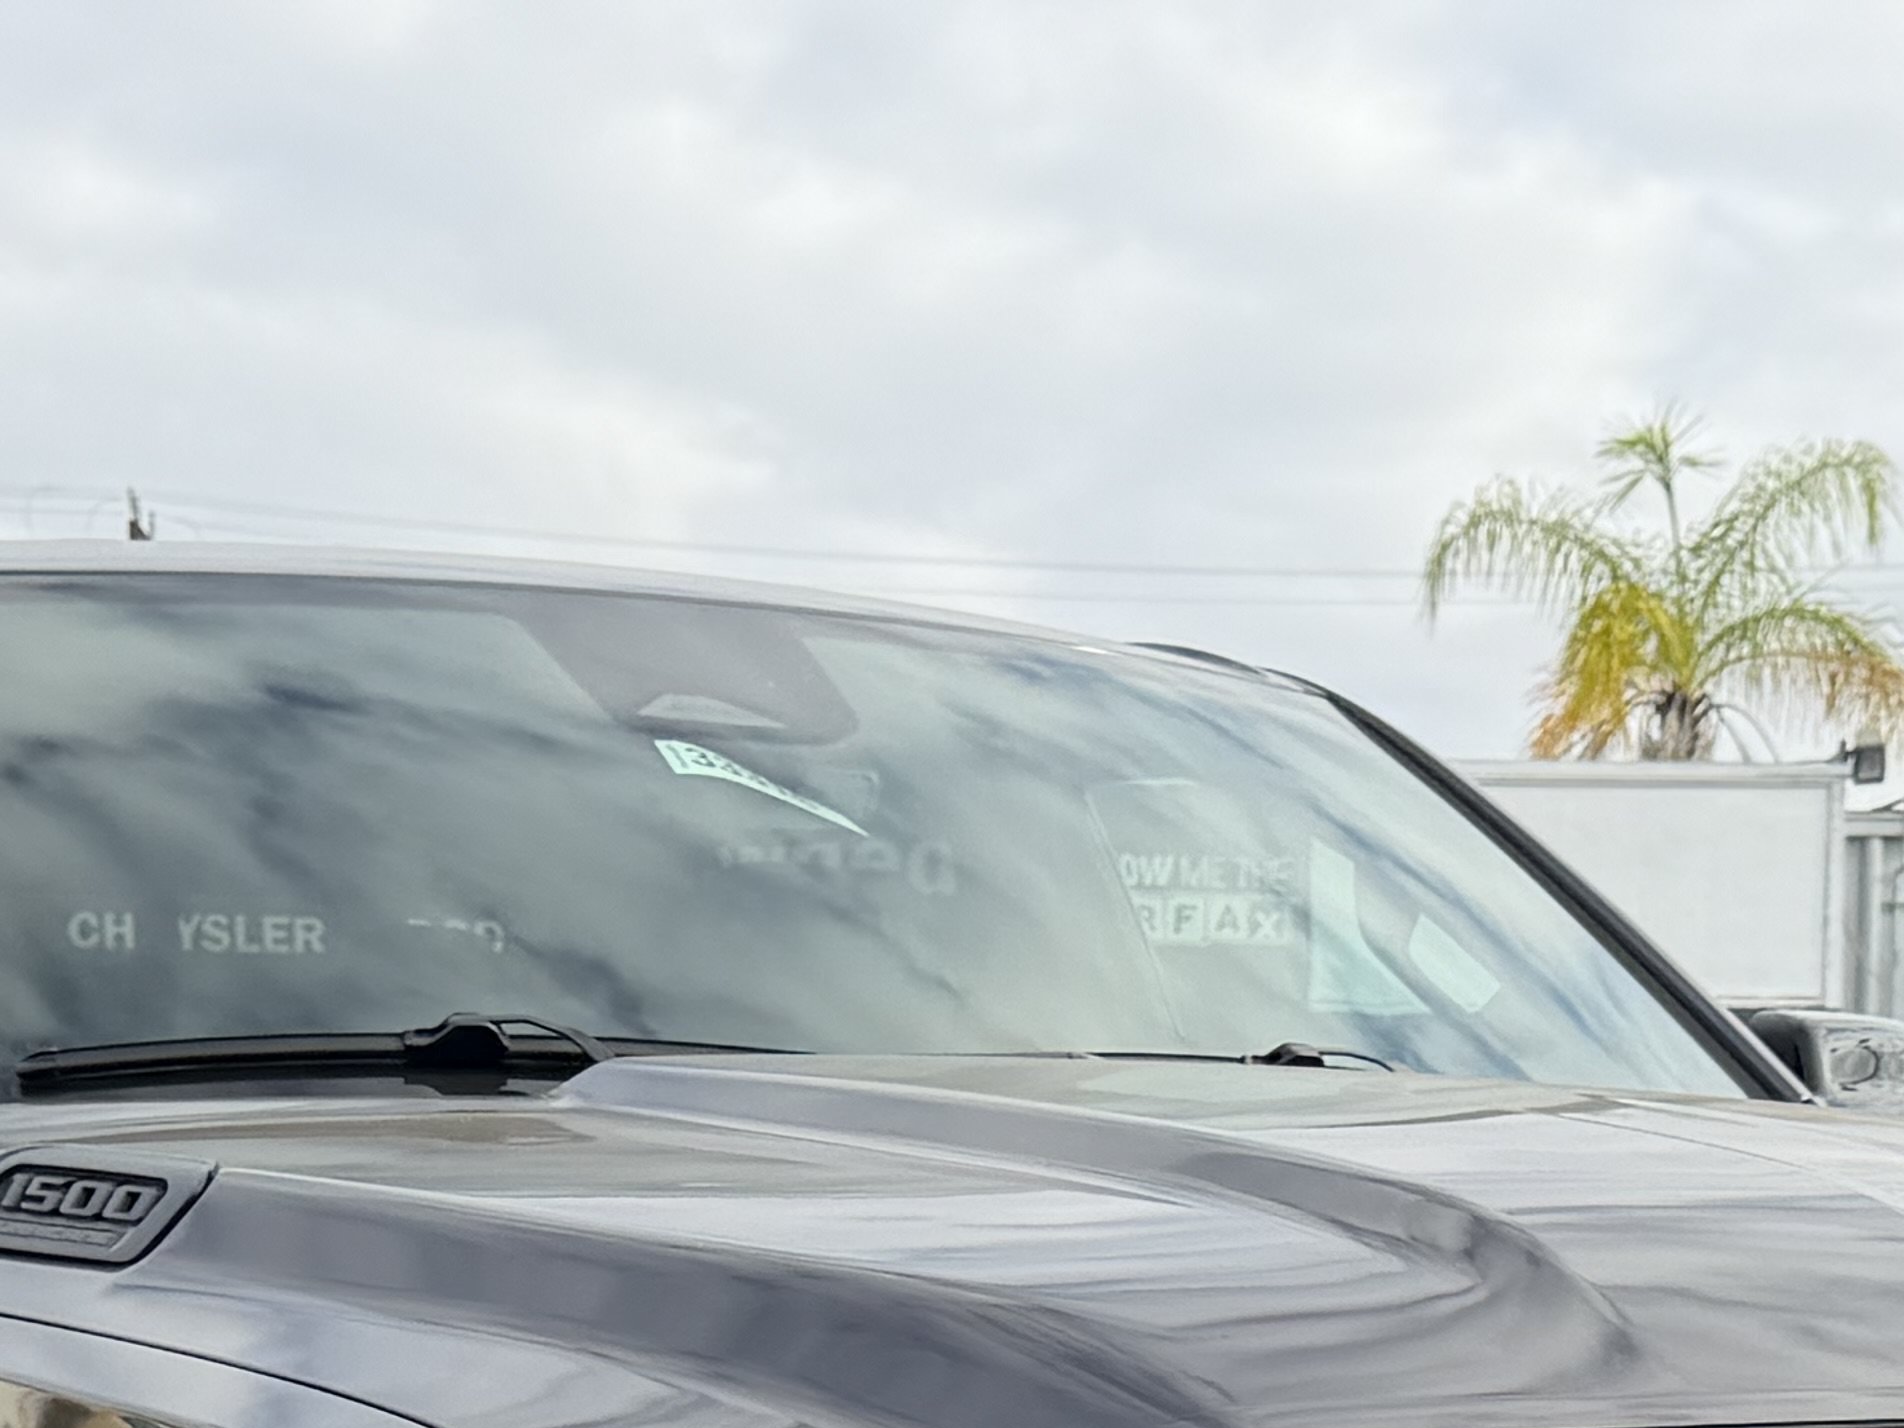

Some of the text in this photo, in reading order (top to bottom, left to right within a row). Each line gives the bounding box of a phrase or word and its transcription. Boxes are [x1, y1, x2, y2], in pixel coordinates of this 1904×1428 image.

[1119, 853, 1174, 887] OW
[66, 910, 327, 954] CHYSLER
[1135, 901, 1284, 942] RFAX
[0, 1172, 160, 1222] 1500
